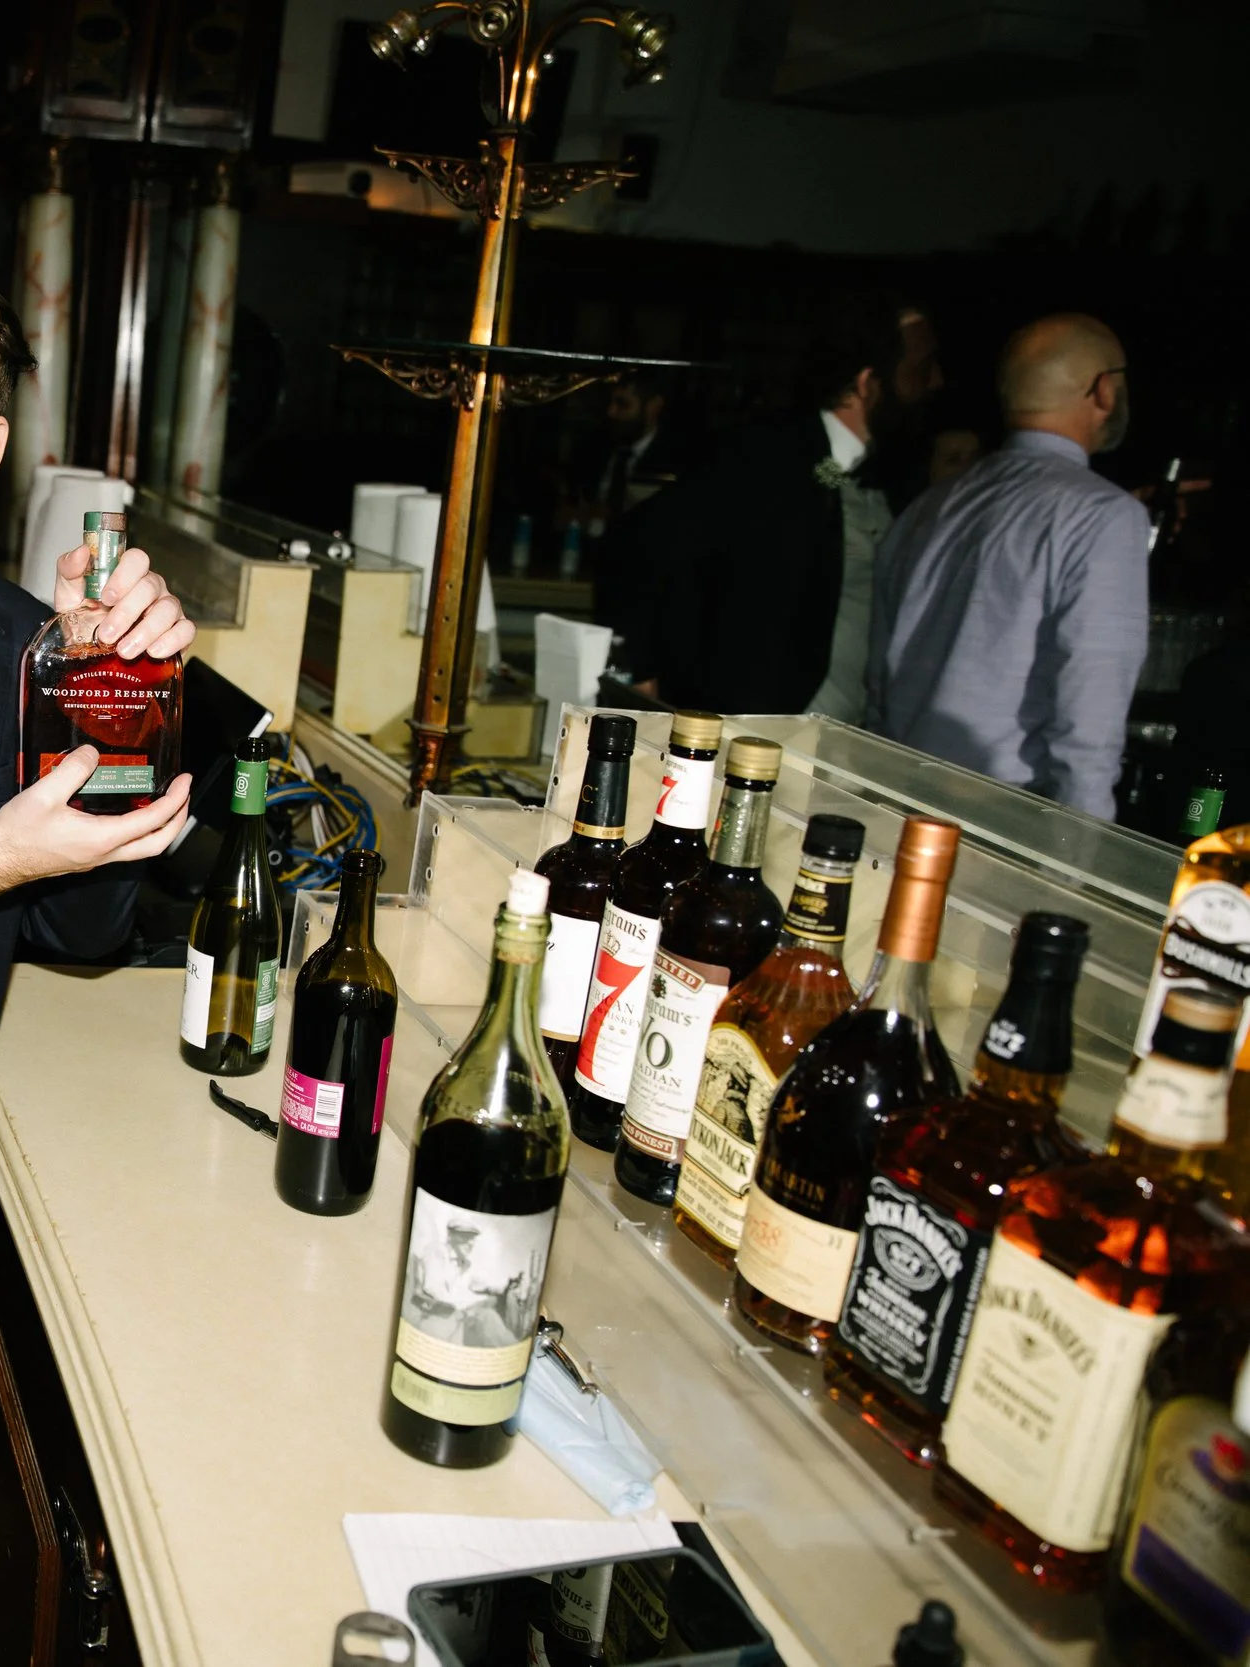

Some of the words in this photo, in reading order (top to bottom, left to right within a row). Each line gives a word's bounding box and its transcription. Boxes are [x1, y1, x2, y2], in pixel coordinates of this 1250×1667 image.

[41, 687, 110, 697] WOODFORD
[114, 689, 168, 698] RESERVE
[72, 671, 113, 682] DISTILLER'S
[655, 775, 679, 817] 7
[576, 948, 646, 1087] 7
[634, 1128, 673, 1153] FINEST
[718, 1137, 750, 1177] JACK
